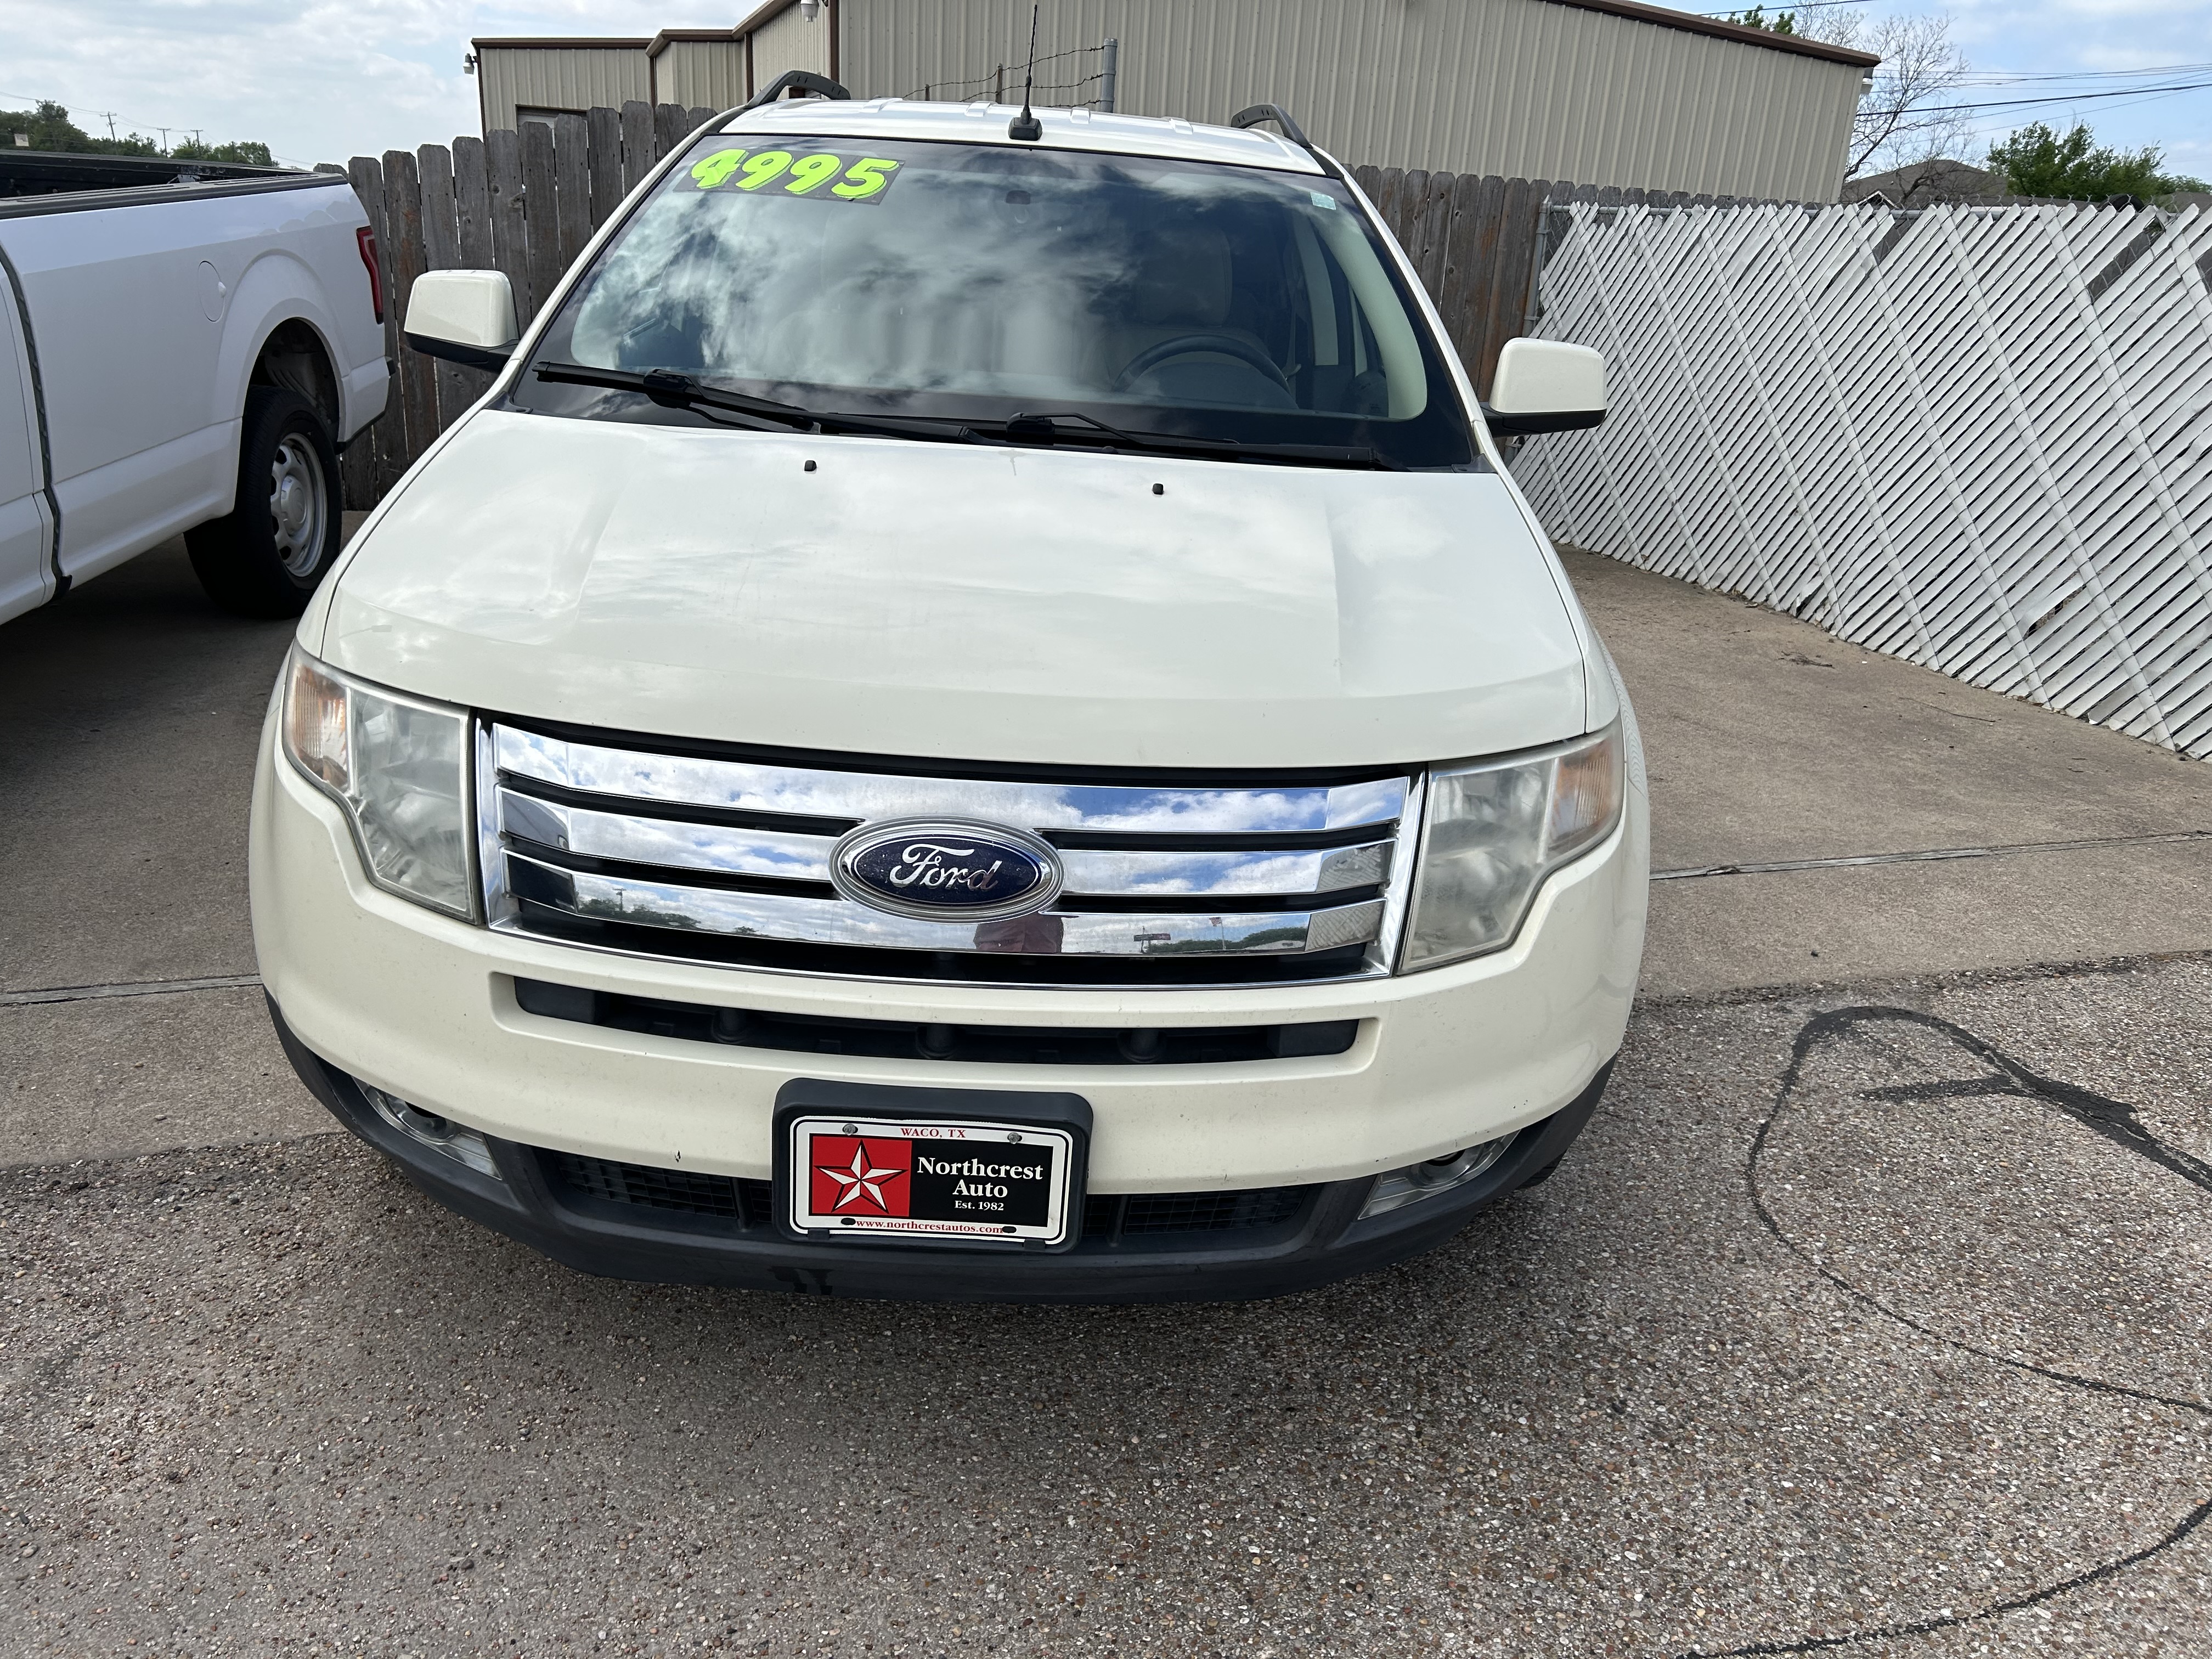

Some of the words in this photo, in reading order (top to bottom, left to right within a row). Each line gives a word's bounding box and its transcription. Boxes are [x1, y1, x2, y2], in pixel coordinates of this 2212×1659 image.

[691, 149, 899, 200] 4995
[889, 843, 1003, 892] Ford
[900, 1128, 942, 1139] WACO,
[947, 1129, 966, 1138] TX
[917, 1156, 1043, 1180] Northcrest
[952, 1179, 1008, 1198] Auto
[955, 1200, 975, 1209] Est.
[978, 1201, 1004, 1211] 1982
[856, 1220, 1003, 1233] www.northcrestautos.com
